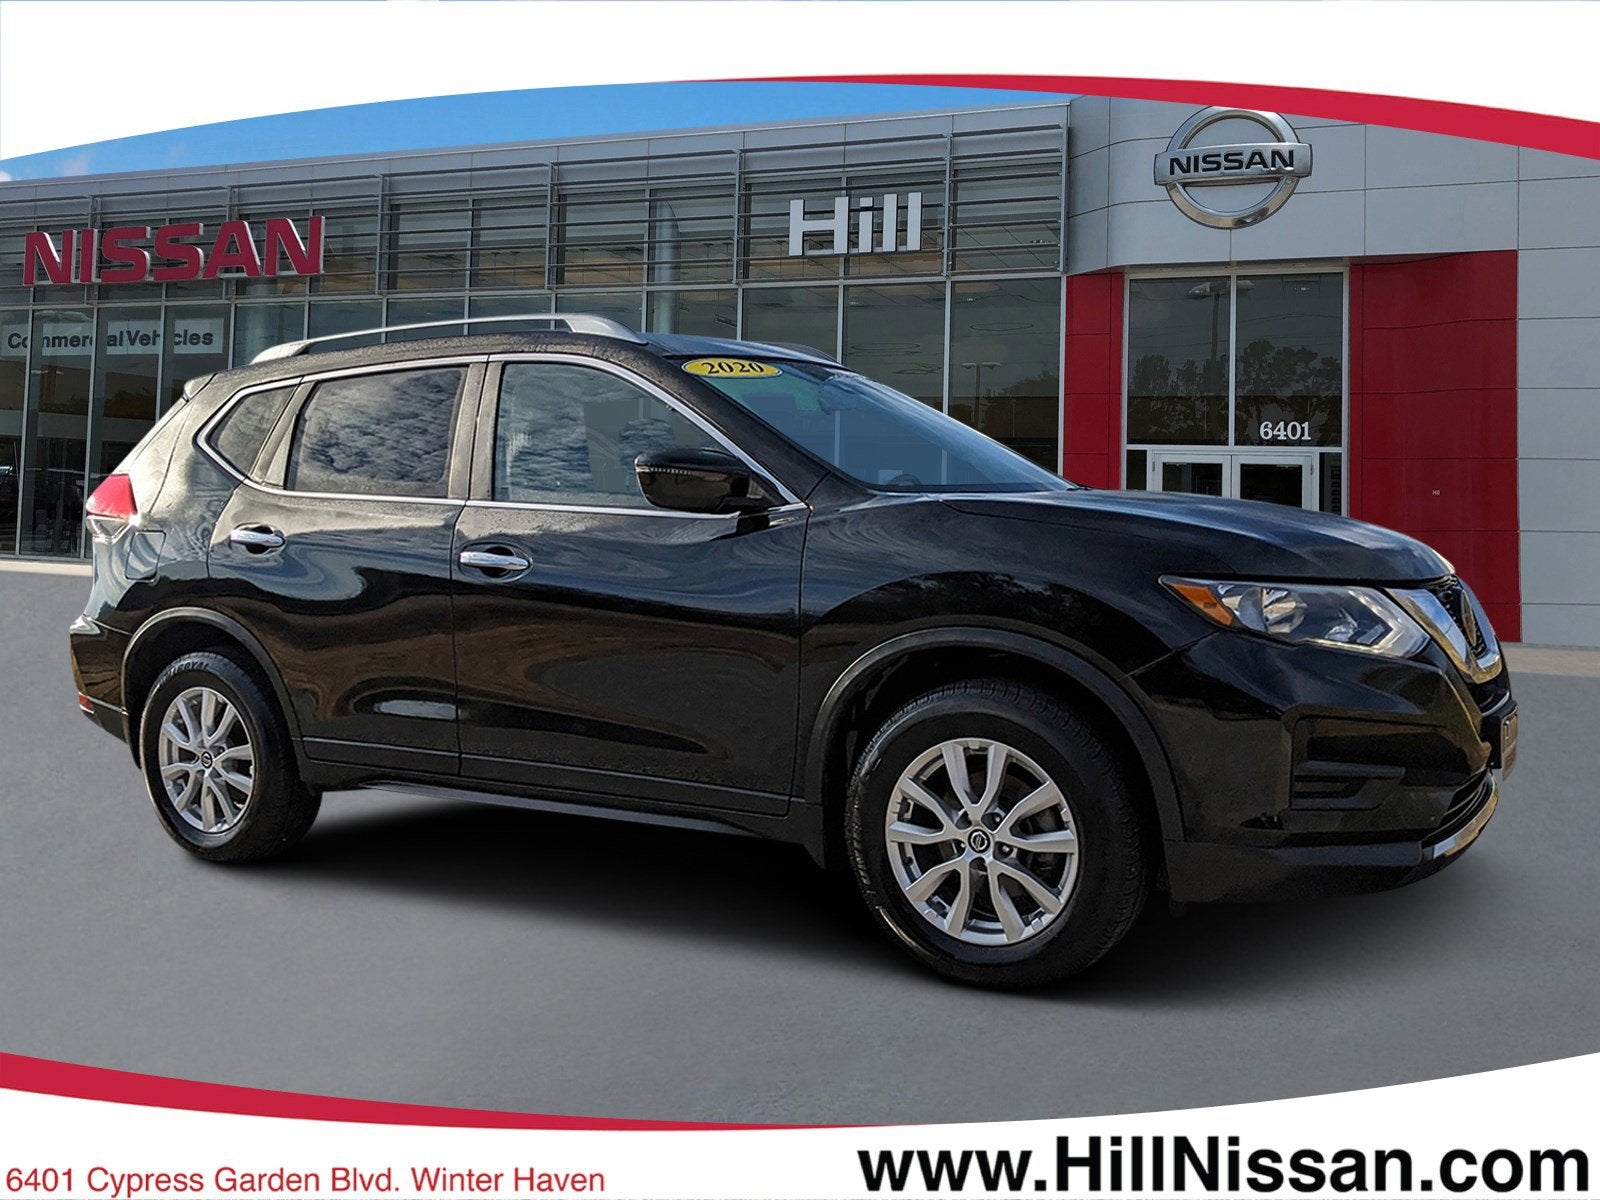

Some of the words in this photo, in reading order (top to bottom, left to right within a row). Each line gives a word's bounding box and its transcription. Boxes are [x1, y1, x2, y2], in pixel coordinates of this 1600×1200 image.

[1169, 149, 1294, 176] NISSAN
[788, 191, 923, 257] Hill
[23, 215, 325, 287] NISSAN
[126, 329, 214, 346] Vehcles
[701, 361, 764, 375] 2020
[1259, 421, 1312, 440] 6401
